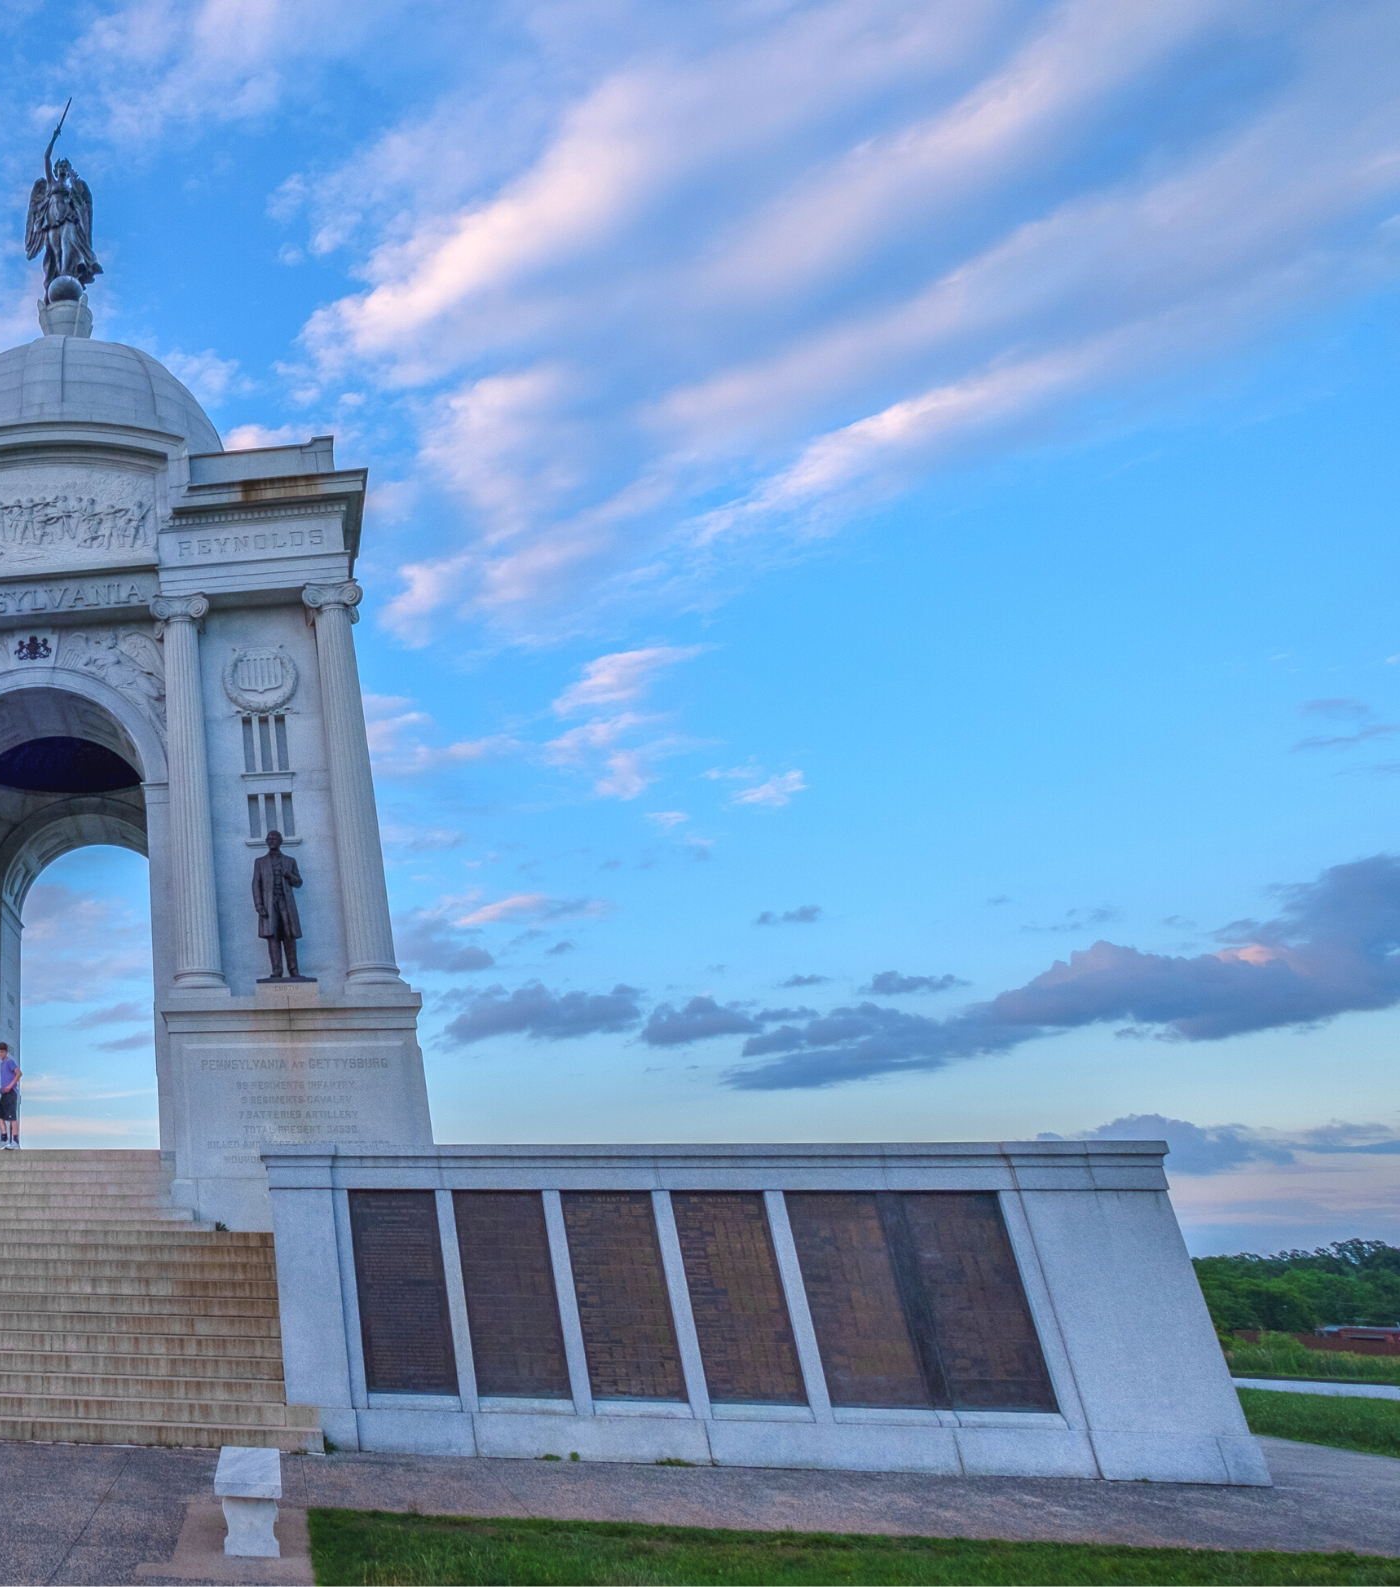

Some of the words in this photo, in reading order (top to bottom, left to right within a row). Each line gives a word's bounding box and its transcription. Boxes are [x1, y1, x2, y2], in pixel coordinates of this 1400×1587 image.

[178, 529, 323, 557] REYNOLDS
[201, 1059, 287, 1071] PENNSYLVANIA
[308, 1057, 389, 1069] GETTYSBURG
[251, 1081, 305, 1090] REGIMENTS
[307, 1080, 355, 1089] INFANTRY
[250, 1095, 305, 1104] REGIMENTS
[307, 1095, 353, 1104] CAVALRY
[238, 1111, 244, 1119] 7
[246, 1110, 302, 1119] BATTERIES
[305, 1110, 358, 1119] ARTILLERY
[243, 1125, 275, 1134] TOTAL
[277, 1125, 322, 1134] PRESENT
[207, 1140, 240, 1149] KILLED
[243, 1140, 261, 1149] AND
